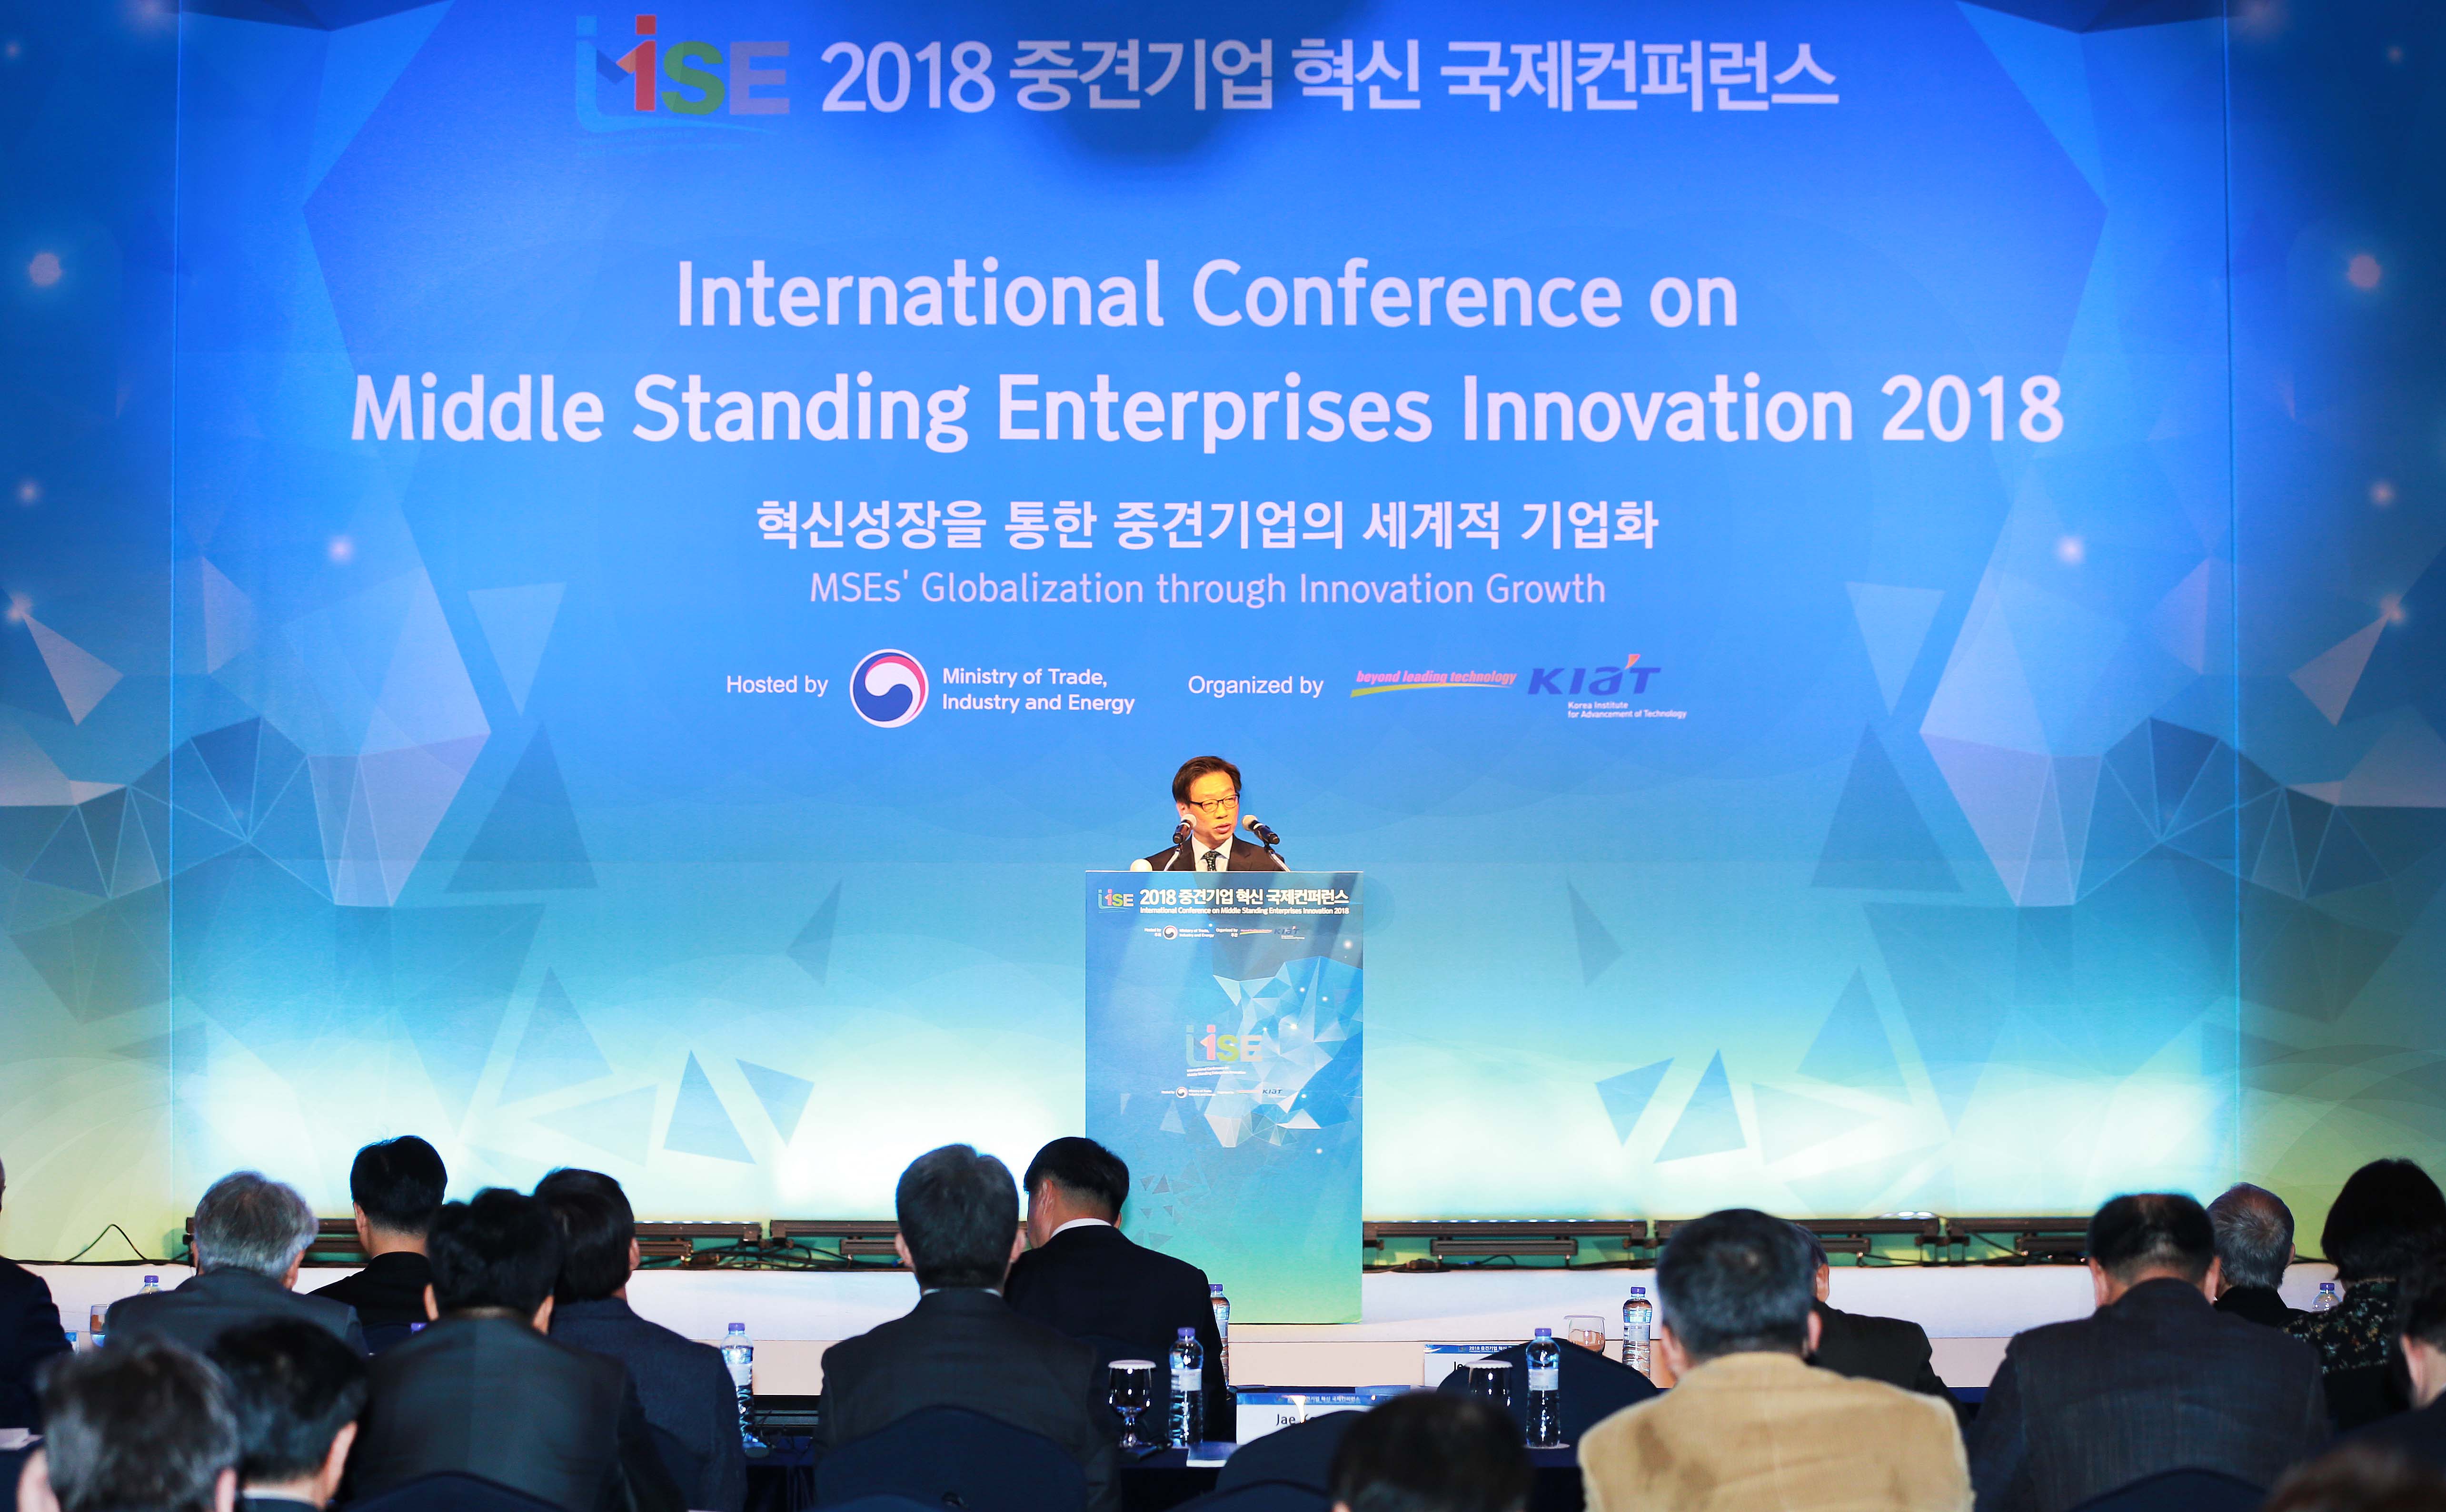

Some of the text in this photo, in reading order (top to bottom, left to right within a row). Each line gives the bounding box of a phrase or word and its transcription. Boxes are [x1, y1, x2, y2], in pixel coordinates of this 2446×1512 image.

[821, 39, 1840, 113] 2018 중견기업 혁신 국제컨퍼런스
[678, 256, 1738, 328] International Conference on
[351, 371, 2065, 455] Middle Standing Enterprises Innovation 2018
[756, 500, 1660, 551] 혁신성장을 통한 중견기업의 세계적 기업화
[810, 570, 1606, 610] MSEs' Globalization through Innovation Growth
[726, 675, 829, 698] Hosted by
[943, 668, 1108, 689] Ministry of Trade,
[1188, 675, 1325, 699] Organized by
[1356, 670, 1518, 685] beyond leading technology
[943, 693, 1136, 715] Industry and Energy
[1568, 710, 1688, 720] for Advancement of Technology
[1139, 889, 1350, 905] 2018 중견기업 혁신 국제컨퍼런스
[1242, 907, 1268, 915] Standing
[1269, 907, 1303, 915] Enterprises
[1276, 1413, 1295, 1425] Jae
